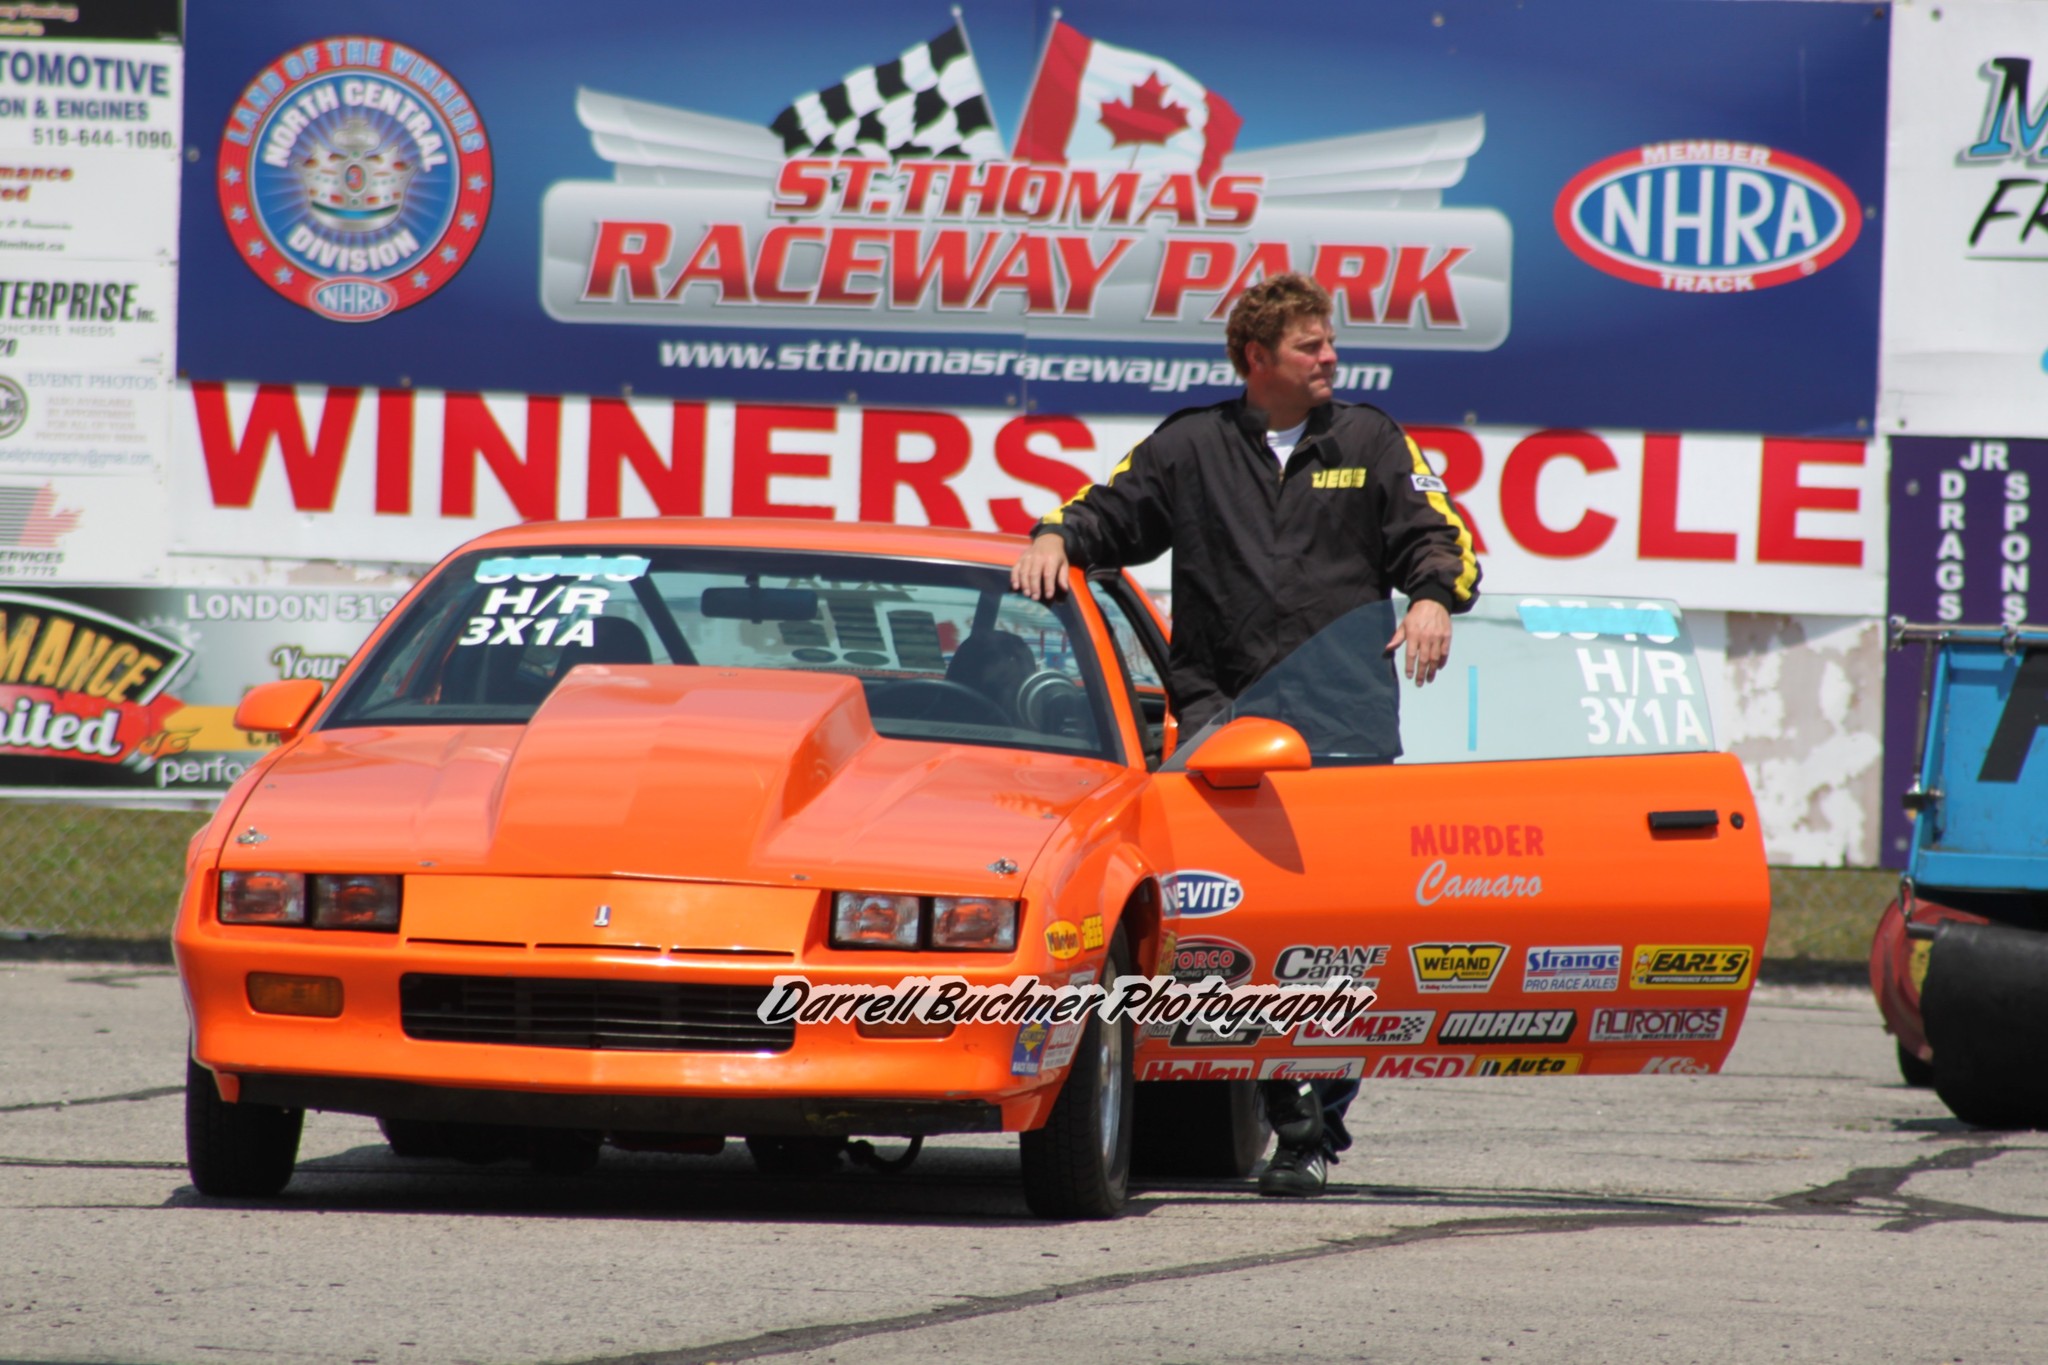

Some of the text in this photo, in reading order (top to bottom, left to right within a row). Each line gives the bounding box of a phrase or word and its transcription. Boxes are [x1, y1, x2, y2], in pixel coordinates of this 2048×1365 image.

[35, 98, 49, 119] &
[56, 100, 150, 122] ENGINES
[227, 40, 486, 155] LAND OF THE WINNERS
[263, 80, 449, 173] NORTH CENTRAL
[1641, 142, 1772, 167] MEMBER
[1602, 166, 1819, 267] NHRA
[287, 224, 421, 273] DIVISION
[581, 220, 1138, 319] RACEWAY
[1145, 238, 1473, 329] PARK
[1660, 271, 1755, 294] TRACK
[321, 284, 386, 314] NHRA
[69, 326, 116, 338] NEEDS
[26, 372, 158, 391] EVENT PHOTOS
[190, 381, 1097, 534] WINNERS
[1958, 441, 2010, 472] JR
[1311, 467, 1368, 489] JEGS
[1405, 430, 1866, 567] RCLE
[1935, 470, 1967, 622] DRAGS
[186, 593, 326, 622] LONDON
[482, 585, 611, 616] H/R
[458, 616, 595, 648] 3X1A
[271, 646, 348, 680] Your
[1576, 646, 1695, 697] H/R
[1579, 696, 1709, 746] 3X1A
[159, 755, 248, 788] perfo
[1410, 824, 1545, 858] MURDER
[1414, 859, 1543, 907] Camaro
[1423, 957, 1491, 971] WEIAND
[1528, 949, 1620, 972] Strange
[1650, 952, 1744, 973] EARL'S
[1524, 977, 1618, 991] PRO RACE AXLES
[1303, 1016, 1403, 1039] CMP
[1365, 1033, 1413, 1042] CAMS
[1437, 1010, 1577, 1041] MOROSO
[1375, 1057, 1466, 1078] MSD
[1503, 1057, 1567, 1074] Auto
